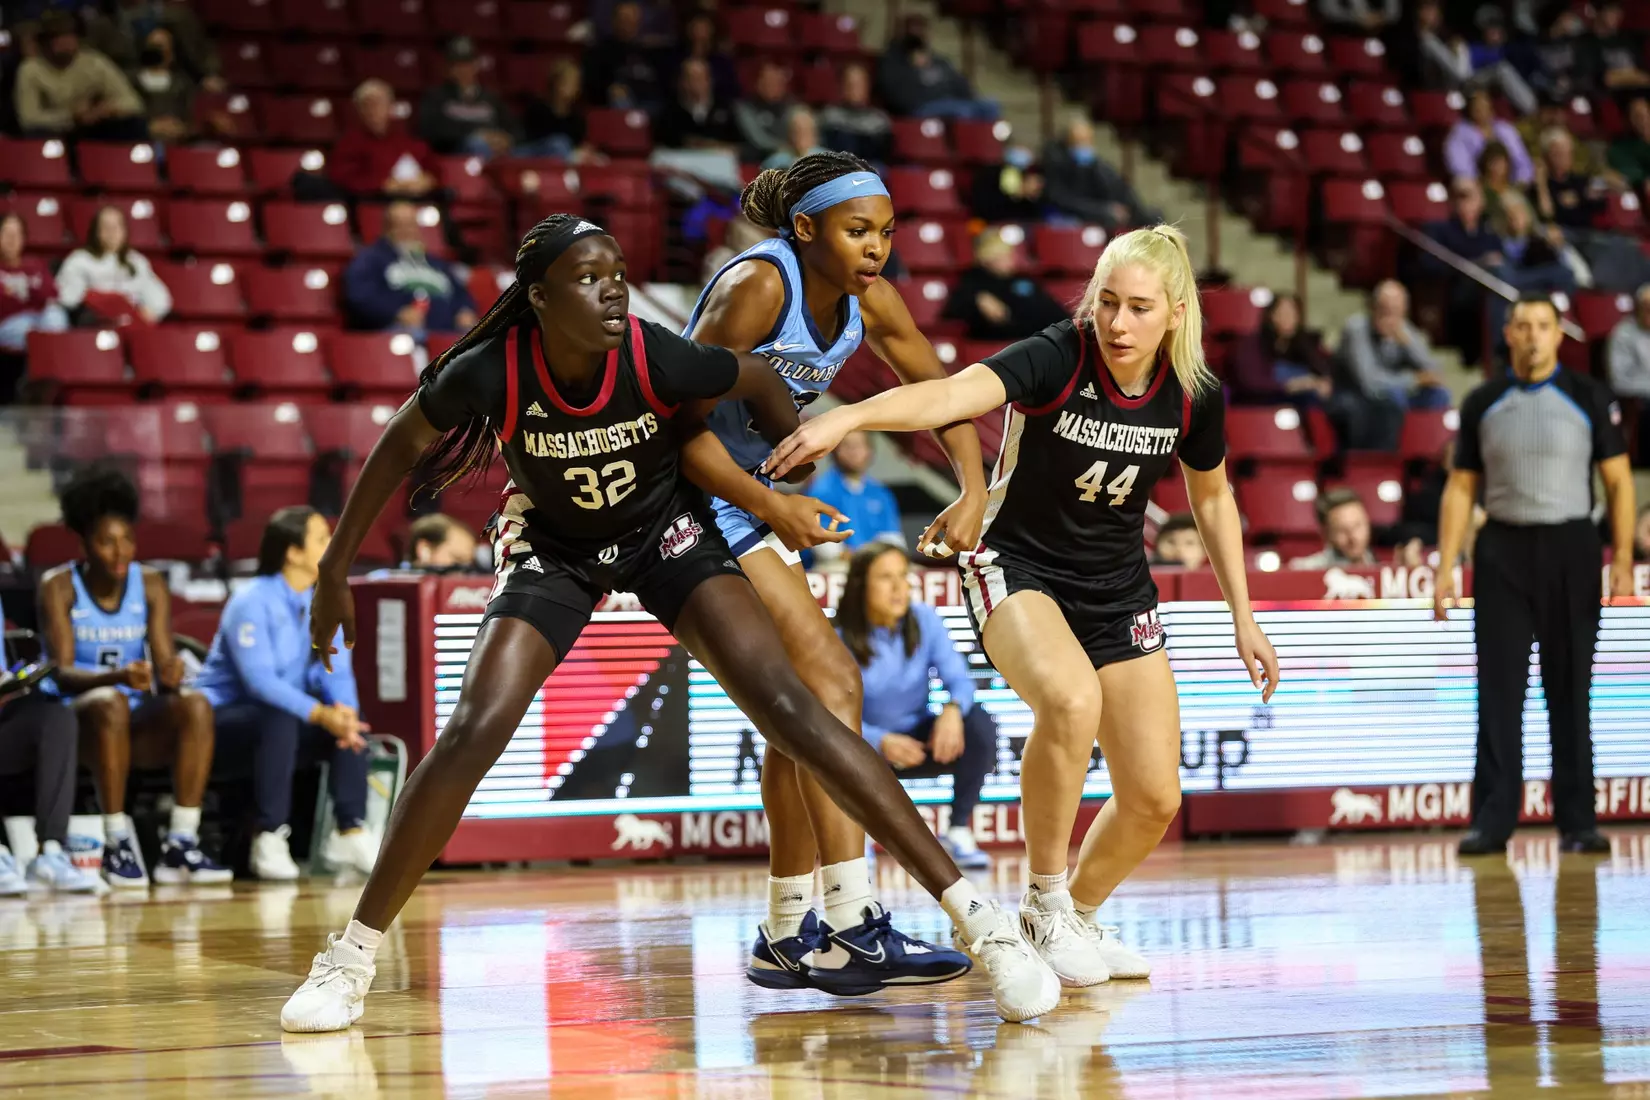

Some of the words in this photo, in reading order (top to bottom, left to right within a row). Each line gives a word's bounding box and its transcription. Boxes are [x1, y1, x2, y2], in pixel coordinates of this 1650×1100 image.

[525, 410, 548, 418] adidas
[1052, 410, 1180, 455] MASSACHUSETTS
[523, 412, 659, 459] MASSACHUSETTS
[563, 459, 637, 510] 32
[1074, 460, 1141, 506] 44
[521, 563, 545, 574] adidas
[1387, 783, 1472, 822] MGM
[680, 809, 771, 849] MGM
